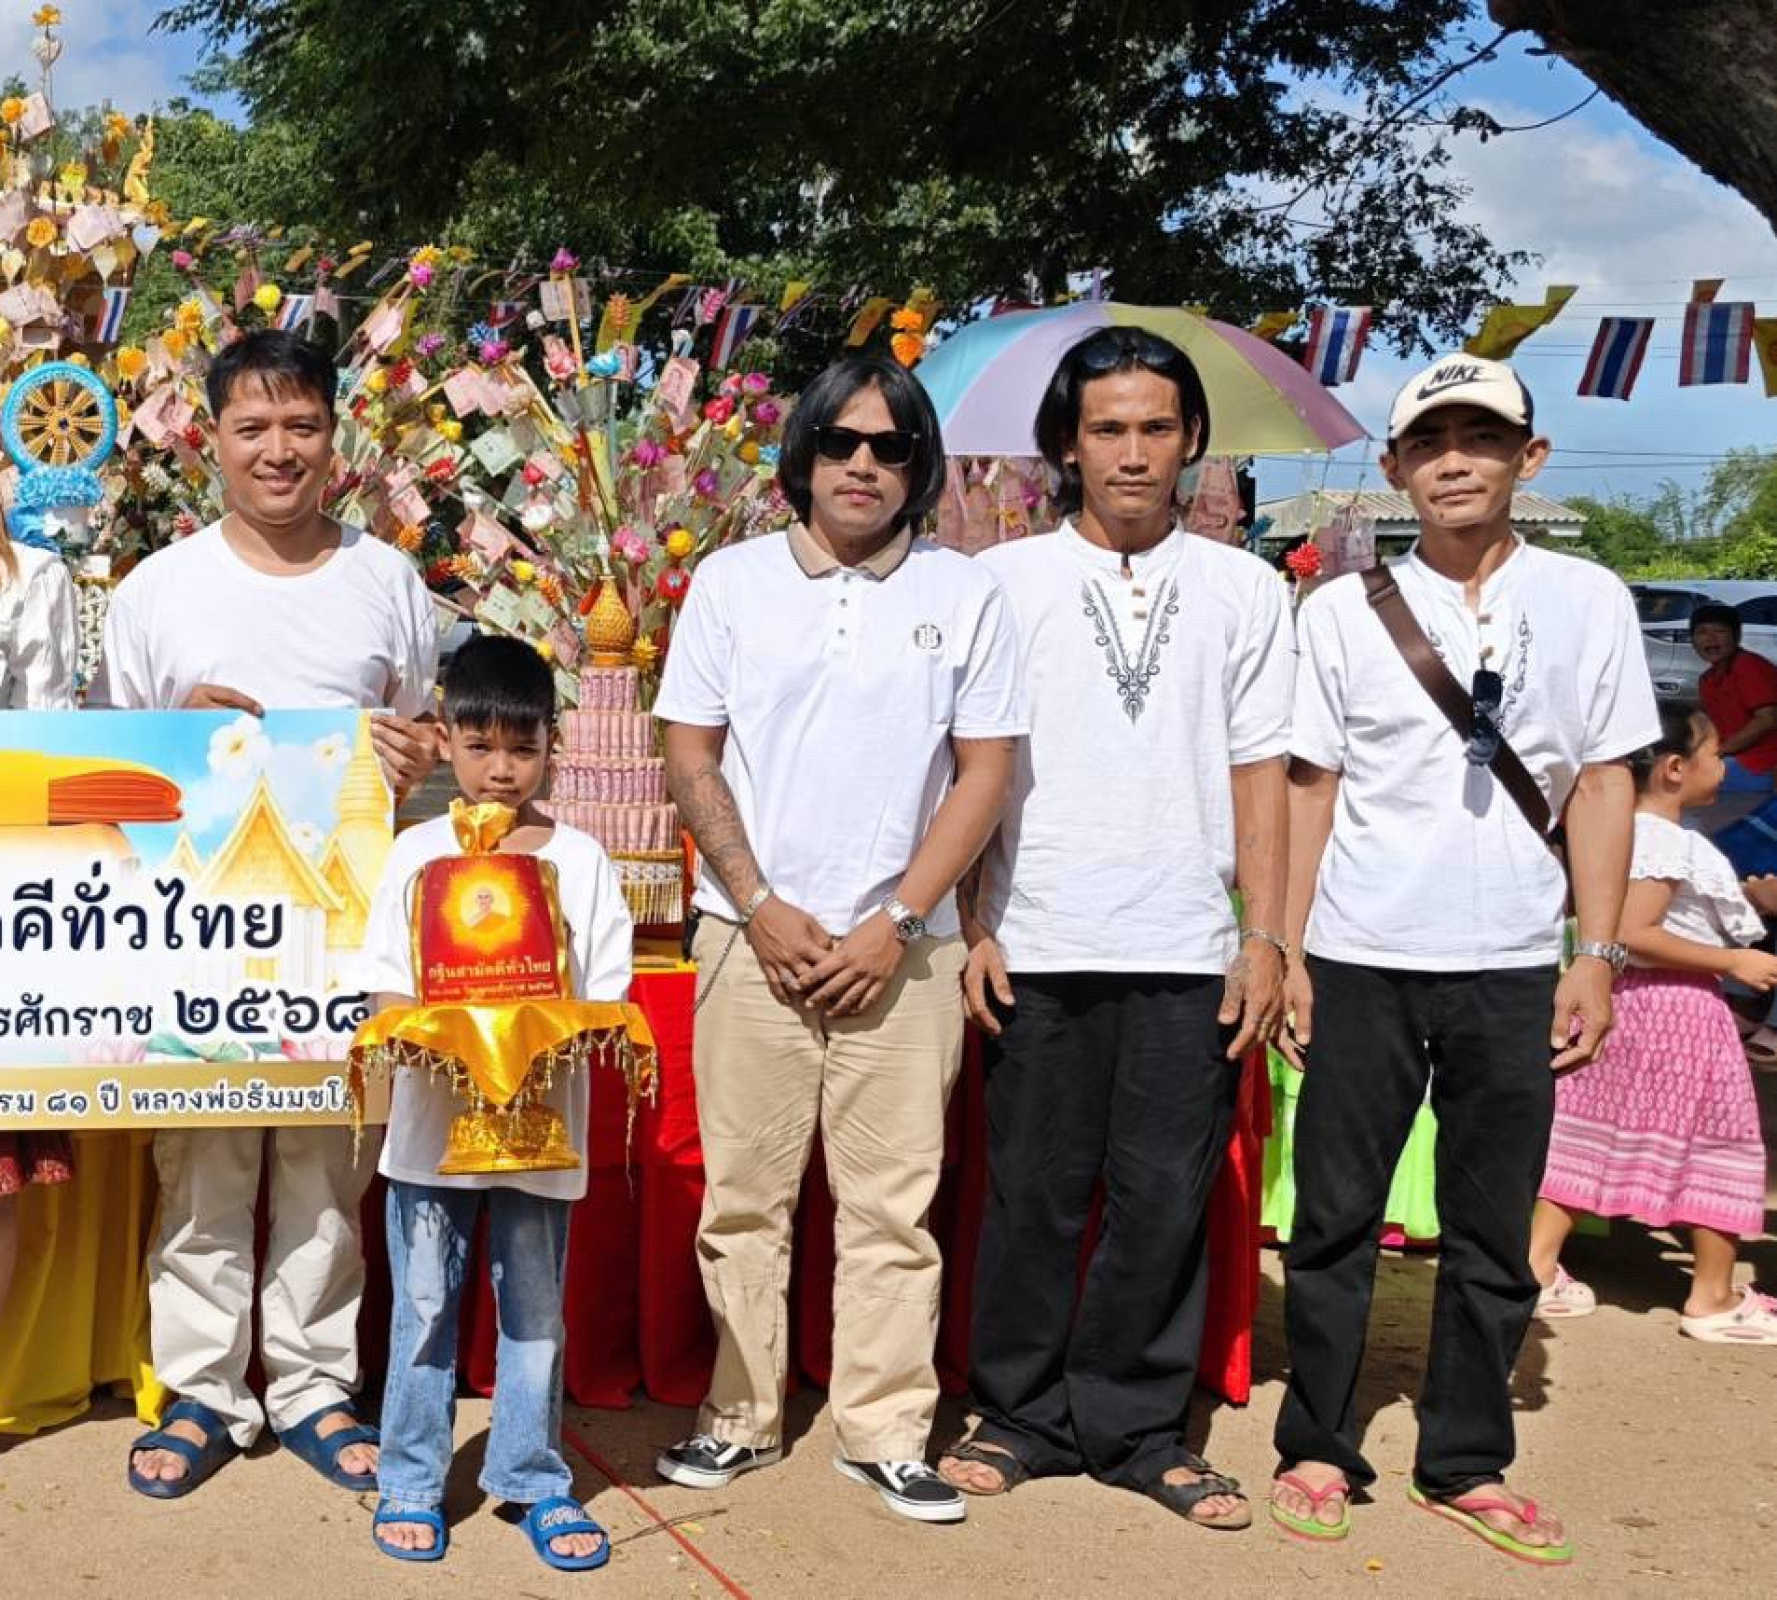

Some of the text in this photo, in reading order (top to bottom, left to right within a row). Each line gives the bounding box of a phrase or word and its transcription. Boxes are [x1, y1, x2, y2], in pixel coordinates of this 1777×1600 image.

[1430, 364, 1485, 385] NIKE
[174, 986, 370, 1034] ๒๕๖๘
[47, 1094, 88, 1113] ๘๑
[100, 1082, 119, 1111] ปี
[132, 1080, 351, 1111] หลวงพ่อธัมมชโ
